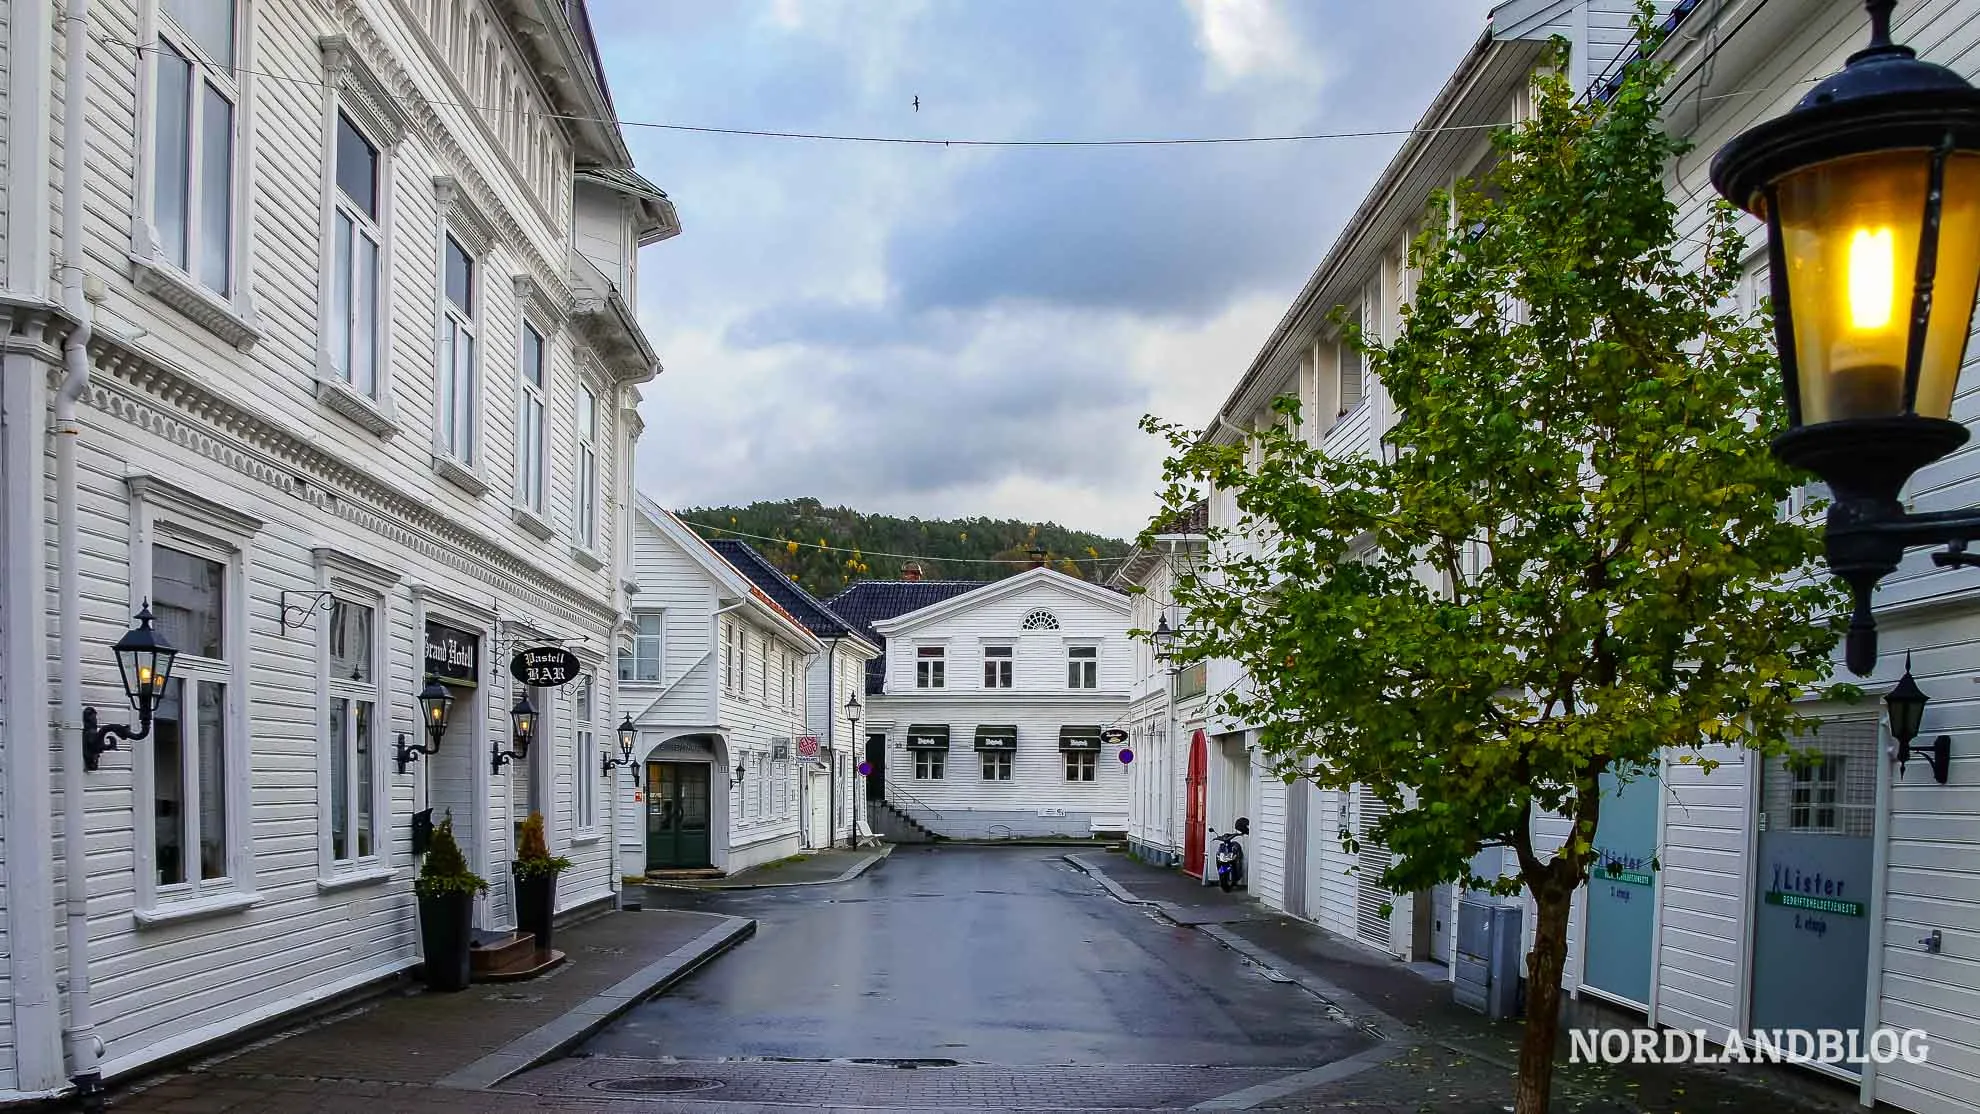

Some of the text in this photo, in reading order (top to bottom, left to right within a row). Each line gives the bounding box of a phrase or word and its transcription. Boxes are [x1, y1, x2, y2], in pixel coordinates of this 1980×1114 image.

[524, 652, 565, 666] Pastell
[526, 667, 566, 683] BAR
[1783, 867, 1845, 897] Lister
